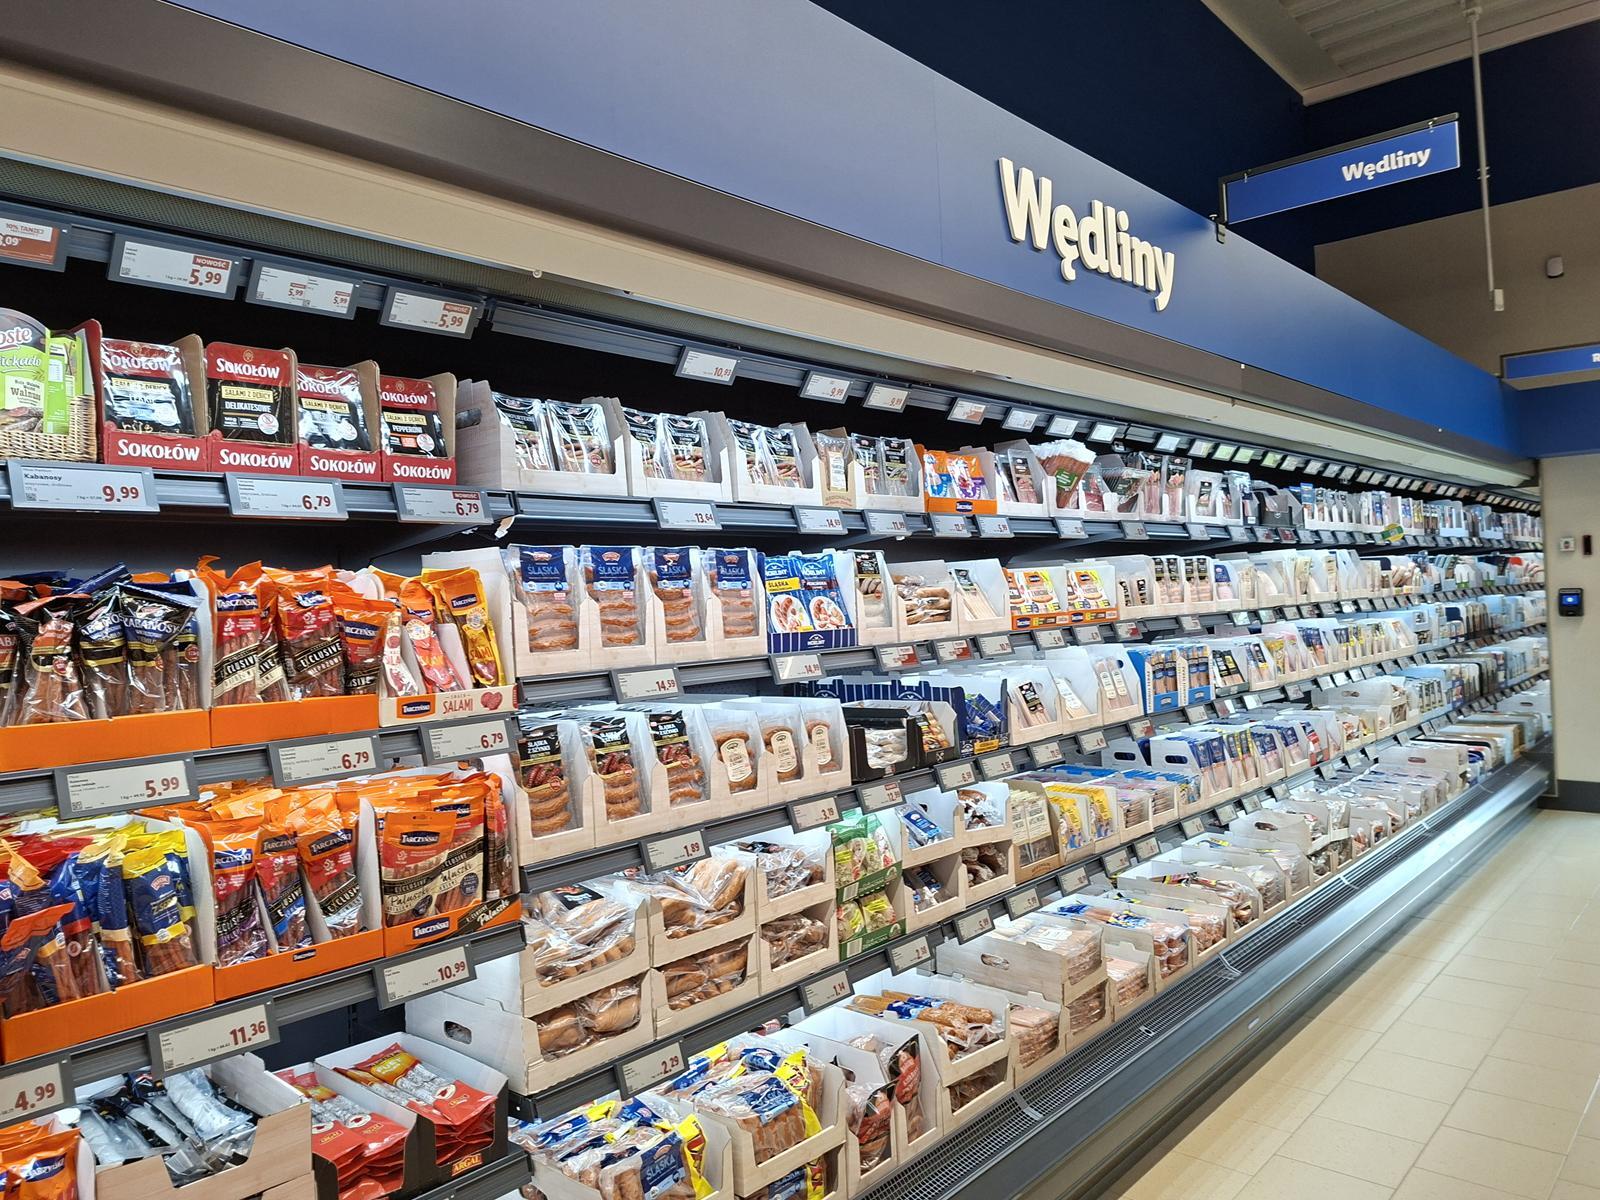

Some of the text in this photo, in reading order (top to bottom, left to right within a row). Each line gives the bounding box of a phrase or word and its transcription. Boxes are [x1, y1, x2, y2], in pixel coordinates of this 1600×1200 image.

[1342, 147, 1431, 181] Wędliny
[999, 157, 1175, 312] Wędliny
[188, 268, 222, 286] 5.99
[438, 314, 464, 328] 5.99
[216, 357, 280, 379] SOKOŁÓW
[118, 439, 200, 461] SOKOŁÓW
[219, 449, 293, 469] SOKOŁÓW
[310, 455, 377, 474] SOKOŁÓW
[393, 462, 452, 480] SOKOŁÓW
[23, 473, 63, 482] Kabanosy
[102, 485, 140, 503] 9.99
[302, 495, 331, 510] 6.79
[456, 502, 479, 516] 6.79
[443, 698, 473, 714] SALAMI
[480, 732, 504, 749] 6.79
[341, 751, 370, 770] 6.79
[145, 777, 180, 798] 5.99
[438, 961, 466, 981] 10.99
[229, 1020, 266, 1046] 11.36
[14, 1082, 56, 1111] 4.99
[453, 1154, 482, 1174] ARGAL
[646, 1155, 676, 1181] ŚLĄSKA
